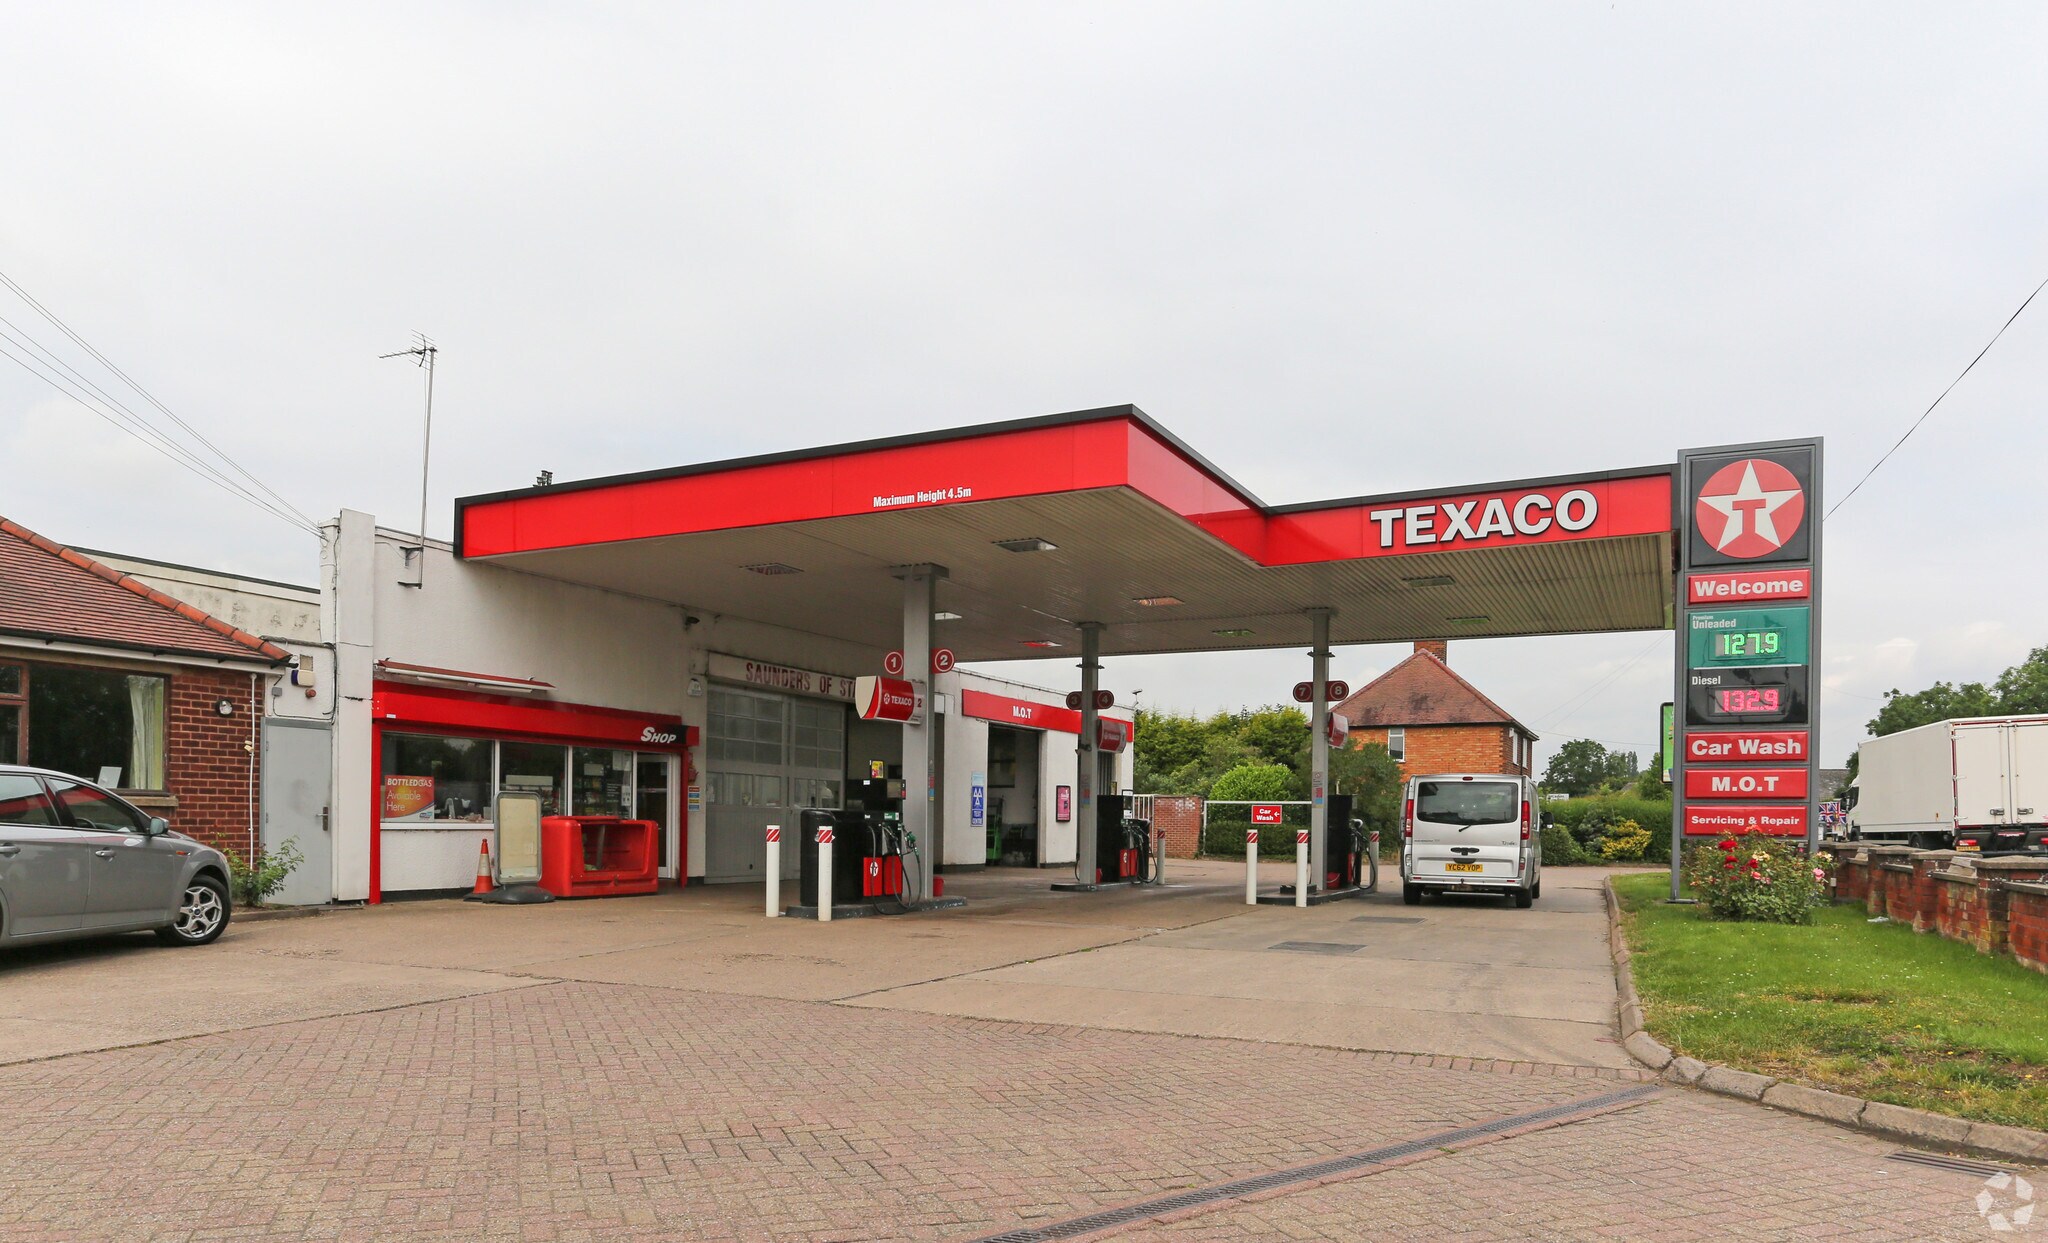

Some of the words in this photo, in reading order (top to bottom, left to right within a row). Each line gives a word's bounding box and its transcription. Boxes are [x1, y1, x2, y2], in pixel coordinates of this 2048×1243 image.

[873, 495, 915, 507] Maximum
[917, 489, 946, 503] Height
[948, 487, 972, 498] 4.5m
[1370, 489, 1598, 547] TEXACO
[1694, 579, 1804, 597] Welcome
[1692, 619, 1736, 629] Unleaded
[1723, 632, 1779, 655] 127.9
[891, 657, 897, 668] 1
[940, 655, 948, 666] 2
[745, 662, 811, 692] SAUNDERS
[819, 675, 832, 694] OF
[1692, 676, 1721, 685] Diesel
[1298, 687, 1306, 697] 7
[1334, 686, 1343, 695] 8
[917, 698, 922, 708] 2
[1012, 705, 1032, 719] M.O.T
[1691, 740, 1732, 755] Car
[1738, 738, 1801, 755] Wash
[1711, 776, 1779, 792] M.O.T
[386, 801, 406, 811] Here
[1691, 815, 1745, 826] Servicing
[1748, 816, 1757, 825] &
[1761, 816, 1799, 826] Repair
[1448, 863, 1465, 871] YC62
